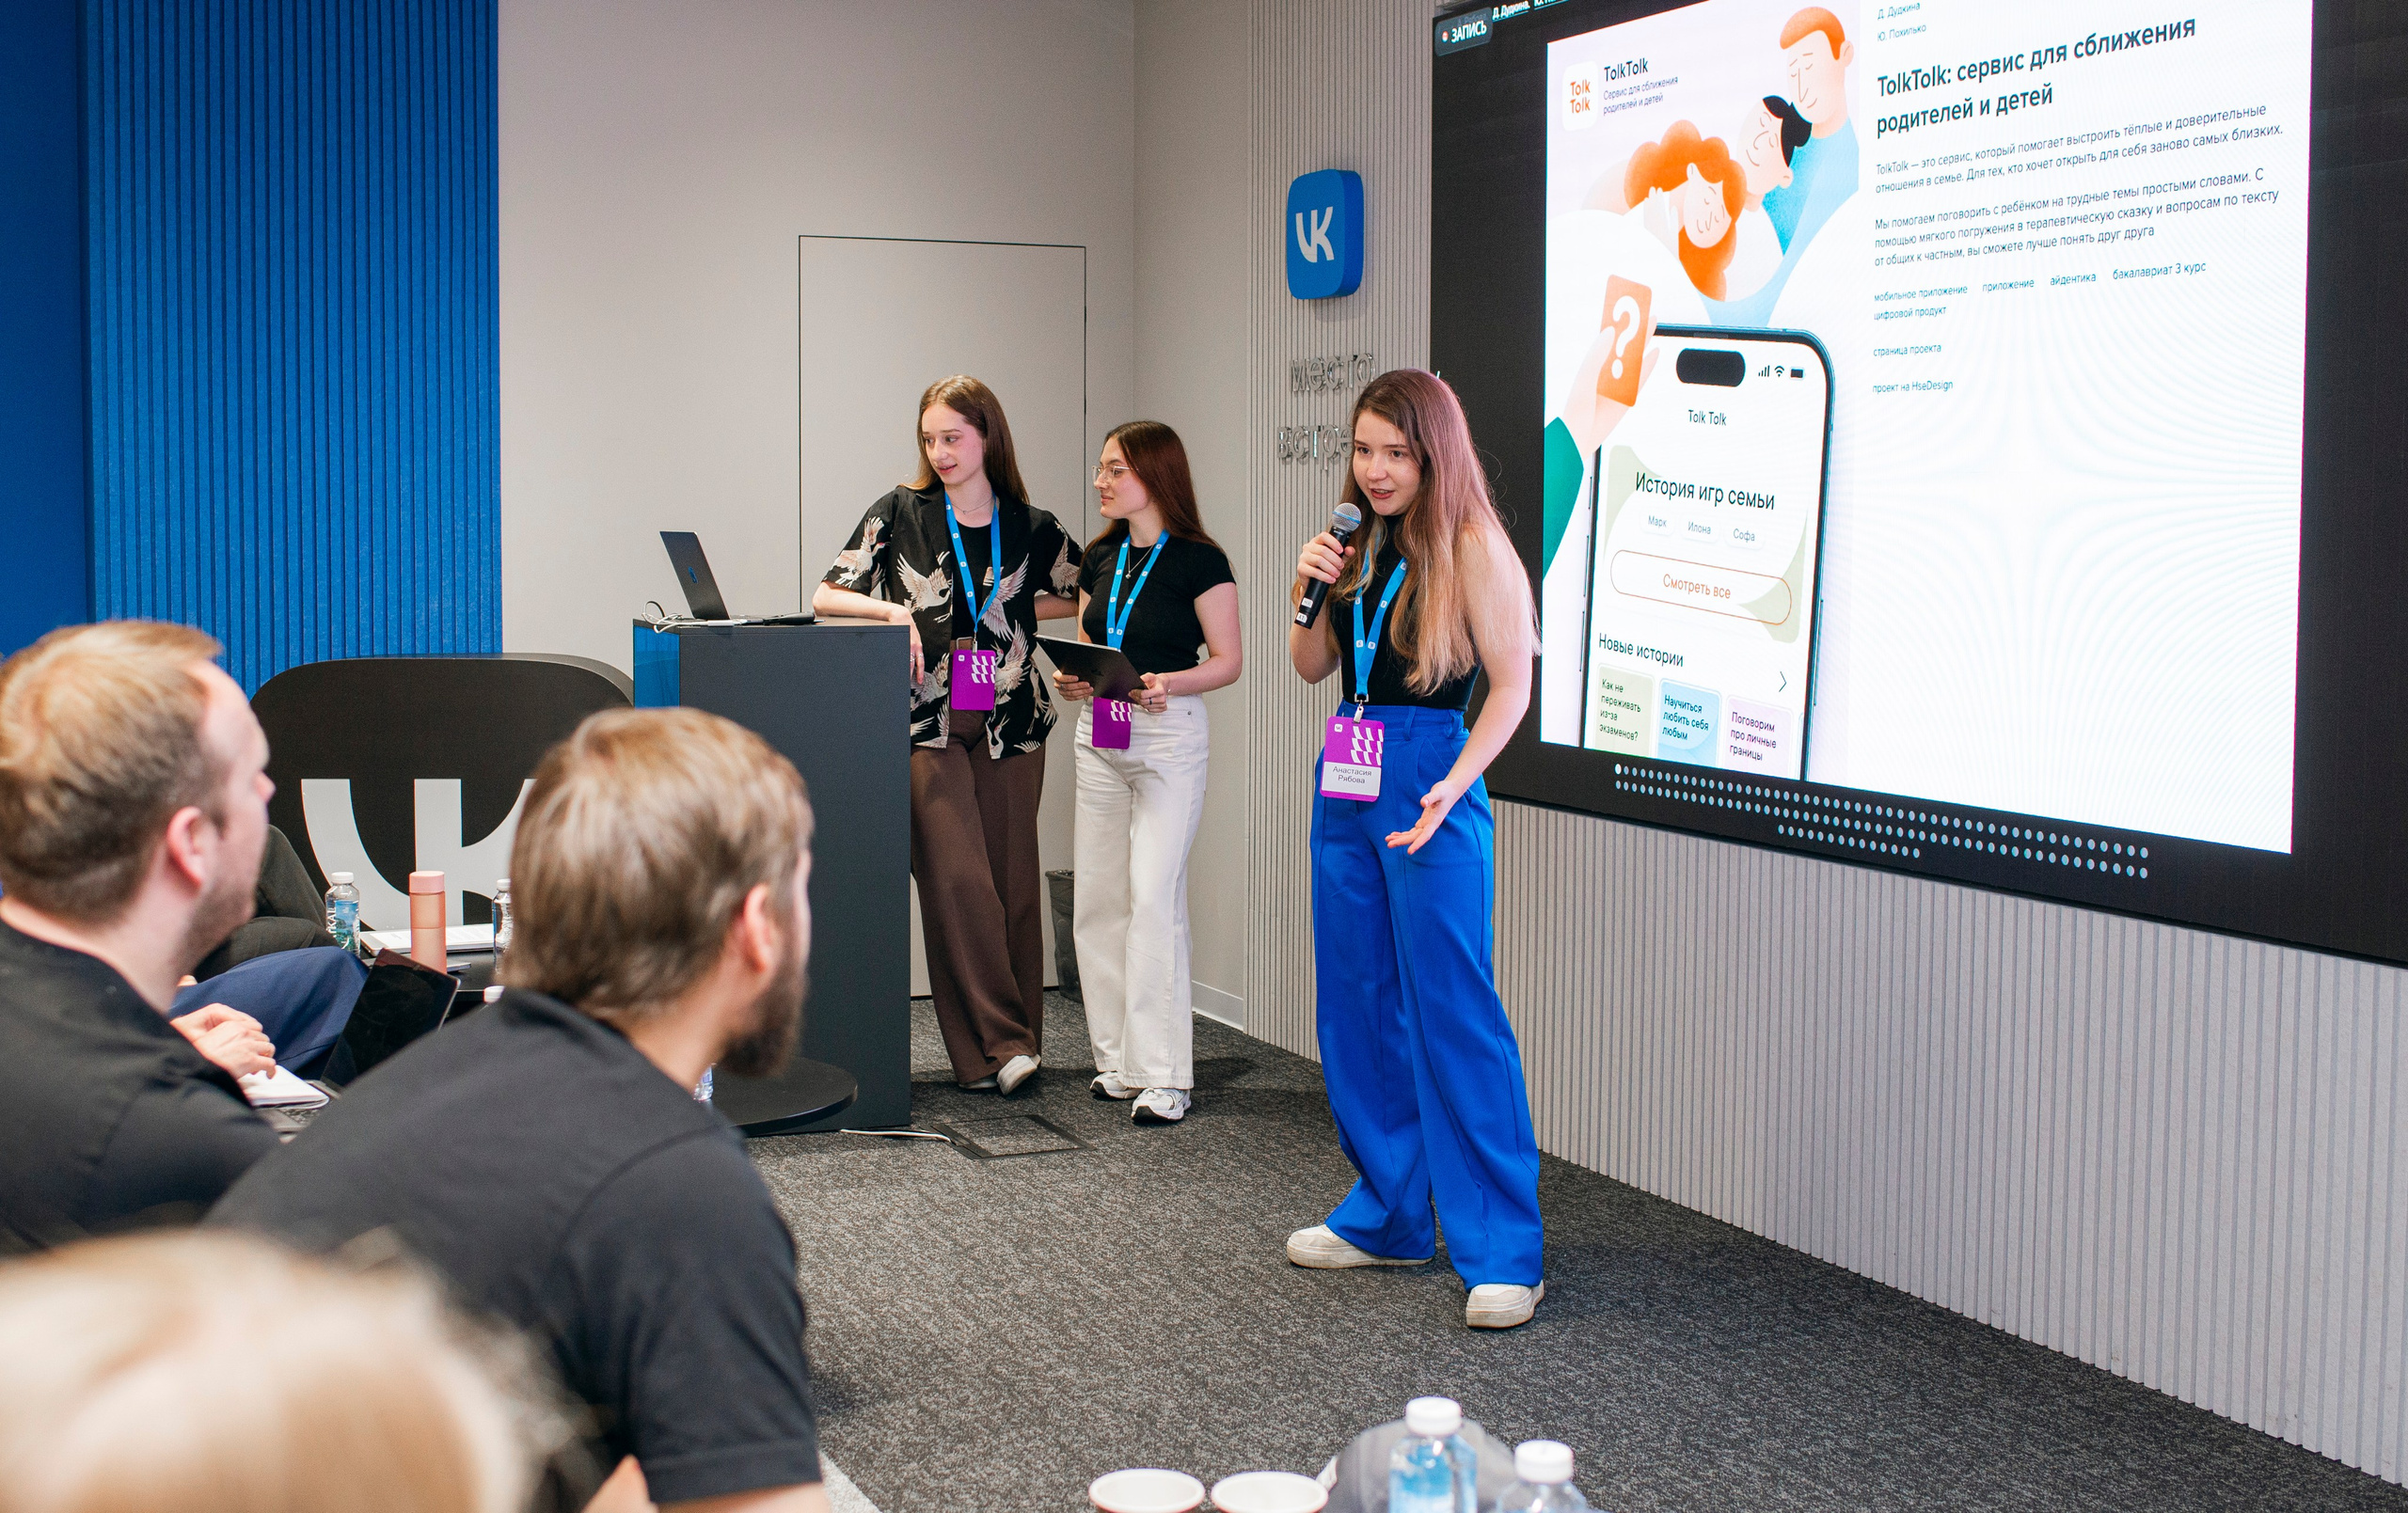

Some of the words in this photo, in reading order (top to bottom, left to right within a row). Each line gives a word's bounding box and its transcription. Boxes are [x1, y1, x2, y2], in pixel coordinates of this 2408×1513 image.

[1887, 2, 1921, 18] Дудкина
[1450, 20, 1487, 43] ЗАПИСЬ
[1889, 24, 1927, 39] Похилько
[1877, 65, 1952, 96] TolkTolk:
[1956, 54, 2025, 84] сервис
[2030, 44, 2067, 71] для
[2073, 19, 2196, 58] сближения
[1604, 58, 1649, 82] TolkTolk
[1570, 81, 1591, 97] Tolk
[1603, 87, 1627, 101] Сервис
[1628, 85, 1641, 96] для
[1641, 76, 1679, 92] сближения
[1570, 98, 1591, 114] Tolk
[1603, 99, 1638, 117] родителей
[1638, 99, 1643, 107] и
[1643, 92, 1664, 107] детей
[1877, 98, 1973, 138] родителей
[1979, 98, 1990, 117] и
[1996, 83, 2053, 117] детей
[1877, 161, 1909, 175] TolkTolk
[1922, 158, 1937, 168] это
[1938, 152, 1973, 166] сервис,
[1975, 143, 2017, 160] который
[2018, 137, 2065, 153] помогает
[2067, 129, 2121, 146] выстроить
[2123, 121, 2163, 136] тёплые
[2165, 119, 2173, 131] и
[2175, 105, 2267, 130] доверительные
[1876, 178, 1925, 194] отношения
[1926, 177, 1932, 187] в
[1934, 173, 1964, 185] семье.
[1966, 167, 1986, 181] Для
[1988, 166, 2005, 177] тех,
[2007, 164, 2024, 174] кто
[2025, 158, 2054, 172] хочет
[2055, 153, 2098, 167] открыть
[2099, 149, 2119, 163] для
[2121, 143, 2147, 158] себя
[2149, 138, 2190, 153] заново
[2193, 133, 2229, 148] самых
[2231, 125, 2283, 141] близких.
[1875, 218, 1890, 230] Мы
[1892, 214, 1936, 228] помогаем
[1937, 207, 1991, 222] поговорить
[1993, 205, 1999, 215] с
[2001, 199, 2050, 215] ребёнком
[2052, 197, 2064, 208] на
[2067, 191, 2111, 208] трудные
[2113, 187, 2140, 199] темы
[2142, 180, 2196, 197] простыми
[2199, 173, 2252, 188] словами.
[2255, 167, 2264, 181] С
[1875, 235, 1917, 248] помощью
[1919, 230, 1956, 243] мягкого
[1957, 223, 2015, 239] погружения
[2017, 222, 2023, 232] в
[2026, 211, 2115, 231] терапевтическую
[2117, 206, 2154, 219] сказку
[2156, 205, 2163, 215] и
[2165, 197, 2221, 213] вопросам
[2224, 195, 2239, 207] по
[2242, 190, 2280, 204] тексту
[1295, 206, 1334, 263] VK
[1875, 257, 1885, 267] от
[1886, 253, 1915, 266] общих
[1916, 253, 1923, 262] к
[1925, 248, 1965, 261] частным,
[1967, 246, 1981, 257] вы
[1983, 242, 2024, 255] сможете
[2025, 237, 2058, 252] лучше
[2060, 233, 2096, 246] понять
[2097, 230, 2122, 244] друг
[2123, 227, 2155, 242] друга
[2050, 274, 2097, 286] айдентика
[2113, 265, 2174, 280] бакалавриат
[2175, 262, 2181, 275] 3
[2183, 262, 2207, 276] курс
[1874, 291, 1917, 302] мобильное
[1919, 286, 1969, 298] приложение
[1982, 279, 2036, 292] приложение
[1874, 307, 1914, 321] цифровой
[1914, 307, 1947, 318] продукт
[1873, 347, 1909, 357] страница
[1909, 344, 1942, 355] проекта
[1290, 353, 1375, 391] место
[1873, 384, 1899, 394] проект
[1901, 384, 1910, 392] на
[1911, 380, 1954, 392] HseDesign
[1687, 409, 1706, 424] Tolk
[1708, 411, 1727, 426] Tolk
[1278, 425, 1353, 470] встре
[1636, 472, 1695, 500] История
[1699, 486, 1724, 508] игр
[1728, 490, 1775, 511] семьи
[1648, 515, 1668, 528] Марк
[1687, 521, 1712, 535] Илона
[1733, 528, 1756, 544] Софа
[1662, 574, 1711, 596] Смотреть
[1713, 586, 1732, 600] все
[1598, 634, 1634, 655] Новые
[1636, 646, 1684, 668] истории
[1602, 679, 1614, 691] Как
[1614, 685, 1624, 694] не
[1601, 695, 1641, 713] переживать
[1664, 694, 1703, 714] Научиться
[1600, 710, 1619, 721] из-за
[1663, 712, 1690, 729] любить
[1691, 718, 1709, 732] себя
[1731, 711, 1776, 733] Поговорим
[1599, 724, 1639, 741] экзаменов?
[1662, 727, 1688, 741] любым
[1730, 729, 1746, 741] про
[1746, 733, 1777, 749] личные
[1729, 745, 1764, 762] границы
[1333, 766, 1371, 776] Анастасия
[1338, 775, 1365, 783] Рябова
